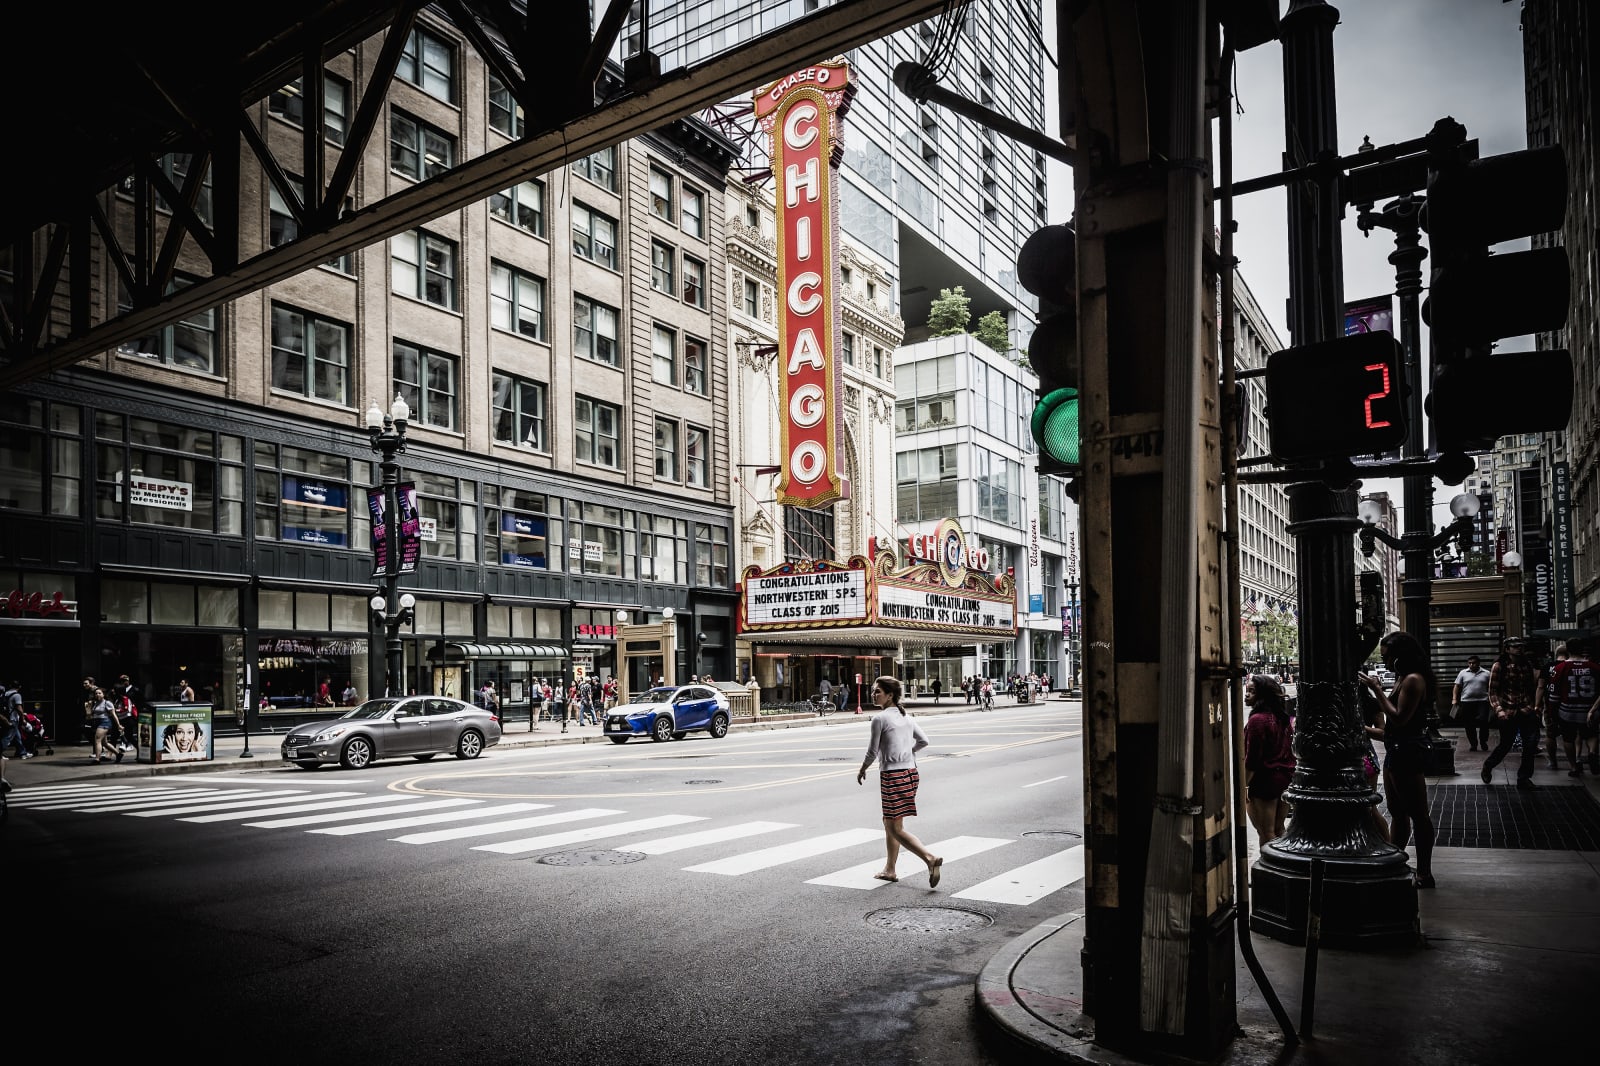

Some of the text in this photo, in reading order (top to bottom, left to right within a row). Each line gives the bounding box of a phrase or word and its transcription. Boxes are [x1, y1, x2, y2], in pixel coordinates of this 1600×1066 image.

[770, 66, 816, 102] CHASE
[784, 104, 827, 486] CHICAGO
[1363, 361, 1392, 430] 2
[130, 481, 189, 496] LEEPY'S
[144, 491, 186, 502] Mattress
[1556, 467, 1566, 501] GENE
[130, 496, 188, 508] ofessionals
[1030, 518, 1041, 568] Walgreens
[1558, 506, 1568, 558] SISKEL
[910, 532, 990, 572] CHICAGO
[1067, 530, 1076, 577] Walgreens
[760, 572, 850, 589] CONGRATULATIONS
[1561, 562, 1570, 584] FILM
[754, 587, 858, 605] NORTHWESTERN SPS
[925, 593, 981, 613] CONGRATULATIONS
[1534, 563, 1550, 614] OLD NAVY
[1562, 586, 1572, 618] CENTER
[771, 604, 840, 619] CLASS OF 2015
[882, 602, 935, 622] NORTHWESTERN
[938, 611, 950, 624] SPS
[952, 613, 970, 626] CLASS
[972, 616, 980, 627] OF
[983, 615, 997, 628] 2015
[1567, 675, 1596, 698] 19
